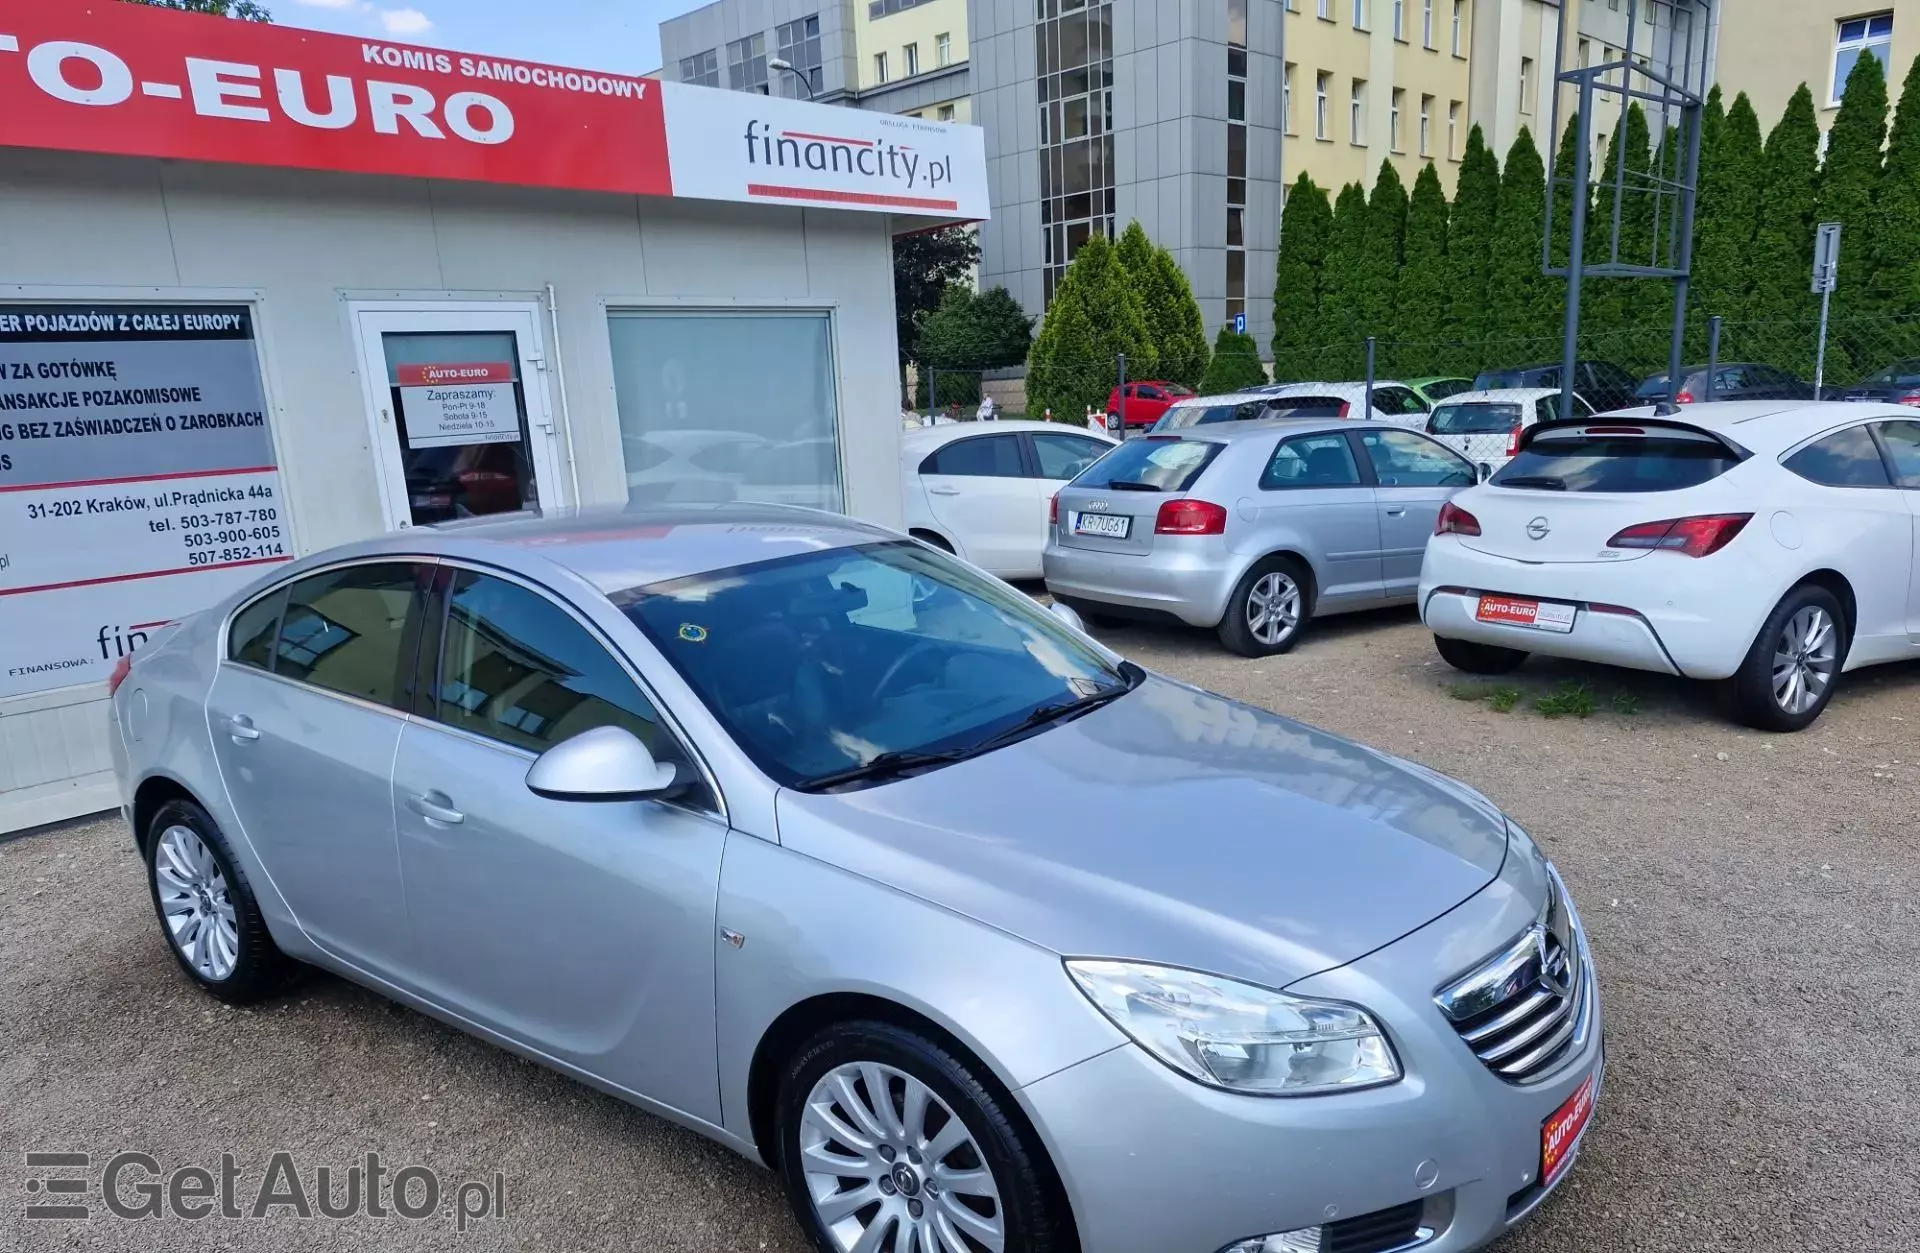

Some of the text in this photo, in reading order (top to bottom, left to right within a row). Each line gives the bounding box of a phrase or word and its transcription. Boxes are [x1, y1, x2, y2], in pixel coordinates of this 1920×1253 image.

[362, 45, 647, 99] KOMIS SAMOCHODOWY
[0, 33, 515, 144] O-EURO
[744, 119, 952, 188] financity.pl
[24, 310, 114, 331] POJAZDÓW
[118, 315, 130, 331] Z
[132, 314, 180, 331] CAŁEJ
[183, 314, 240, 330] EUROPY
[11, 363, 34, 379] ZA
[37, 358, 117, 381] GOTÓWKĘ
[429, 368, 488, 379] AUTO-EURO
[82, 387, 202, 407] POZAKOMISOWE
[18, 422, 51, 439] BEZ
[53, 413, 162, 438] ZAŚWIADCZEŃ
[166, 416, 176, 431] O
[179, 411, 264, 430] ZAROBKACH
[27, 500, 83, 519] 31-202
[86, 496, 151, 514] Kraków,
[248, 484, 273, 499] 44a
[149, 508, 277, 533] tel. 503-787-780
[184, 526, 280, 547] 503-900-605
[189, 543, 284, 565] 507-852-114
[1484, 602, 1536, 617] AUTO-EURO
[9, 658, 94, 677] FINANSOWA:
